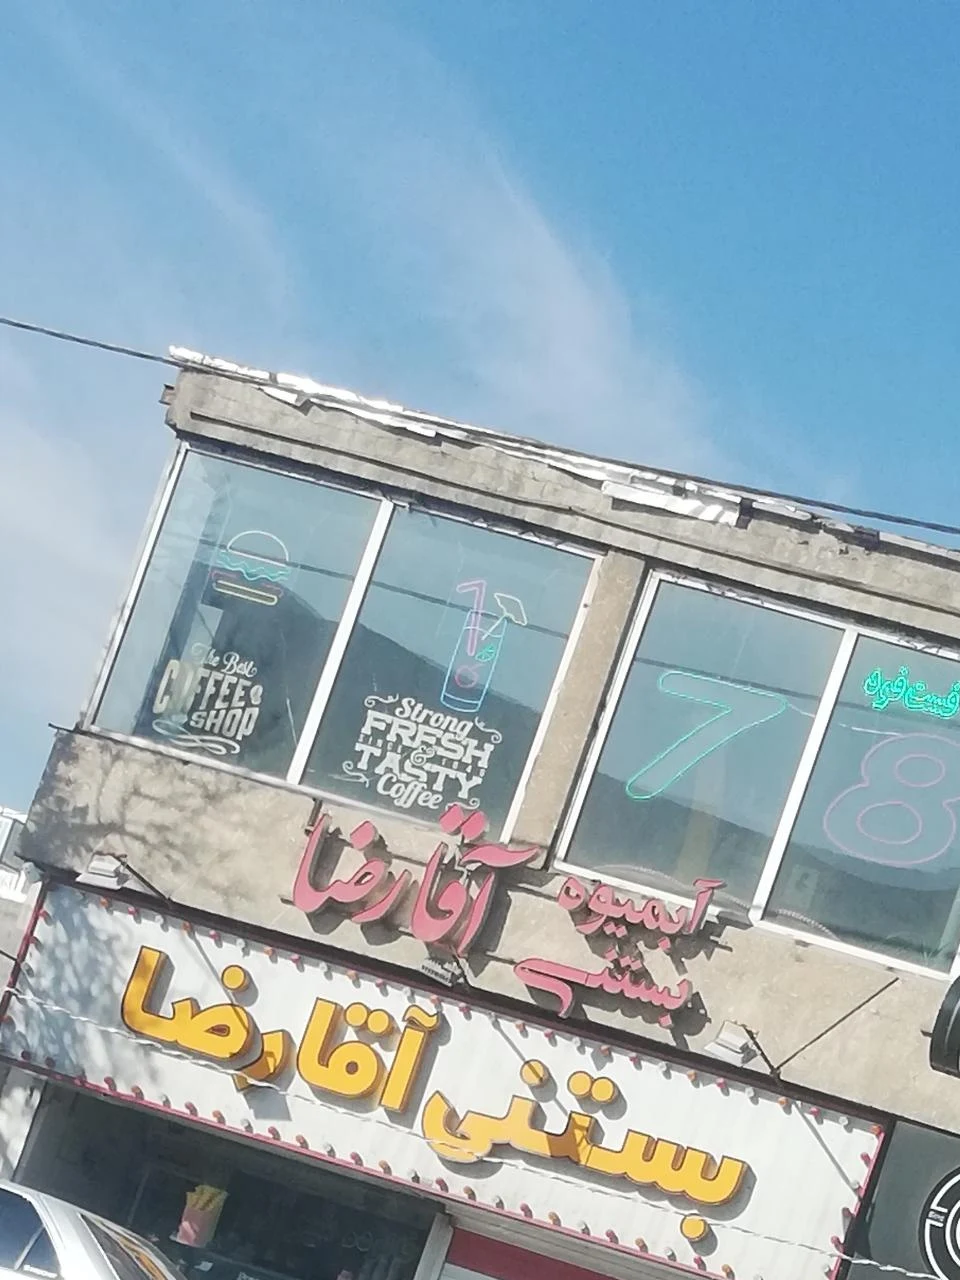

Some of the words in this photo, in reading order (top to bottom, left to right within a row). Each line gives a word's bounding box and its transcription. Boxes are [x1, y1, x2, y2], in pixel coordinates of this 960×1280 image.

[221, 651, 258, 678] Best
[863, 666, 909, 712] فود
[189, 706, 260, 741] SHOP
[395, 698, 474, 741] Strong
[905, 681, 960, 720] فست
[360, 709, 495, 769] FRESH
[410, 745, 435, 766] &
[625, 671, 788, 801] 7
[355, 742, 483, 799] TASTY
[376, 773, 444, 809] Coffee
[293, 814, 411, 924] رضا
[120, 945, 287, 1092] رضا
[297, 997, 439, 1113] آقا
[420, 1059, 752, 1242] بستنی
